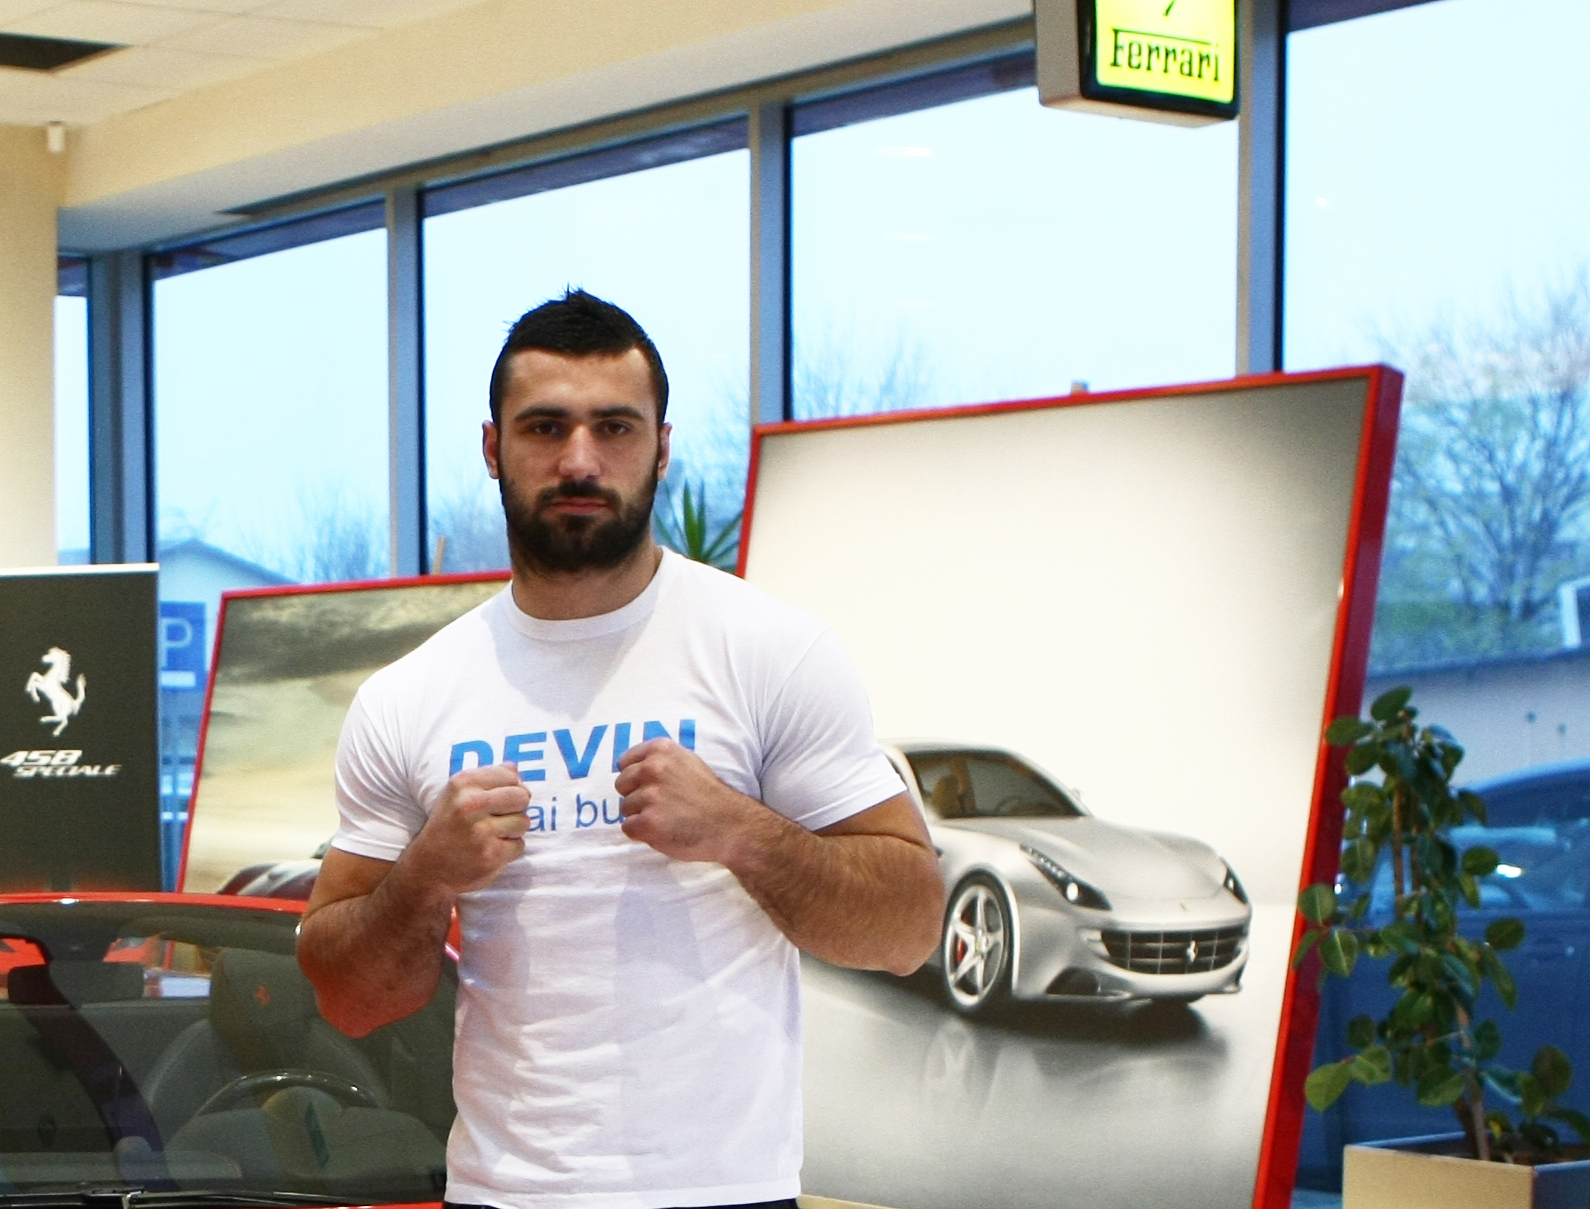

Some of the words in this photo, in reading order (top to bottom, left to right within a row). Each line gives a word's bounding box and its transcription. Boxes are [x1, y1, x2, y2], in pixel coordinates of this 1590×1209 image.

[1110, 28, 1220, 81] Ferrari
[158, 617, 193, 668] P
[0, 749, 83, 767] 458
[13, 764, 122, 777] SPECIALE
[524, 796, 557, 832] ai
[576, 794, 625, 828] bu
